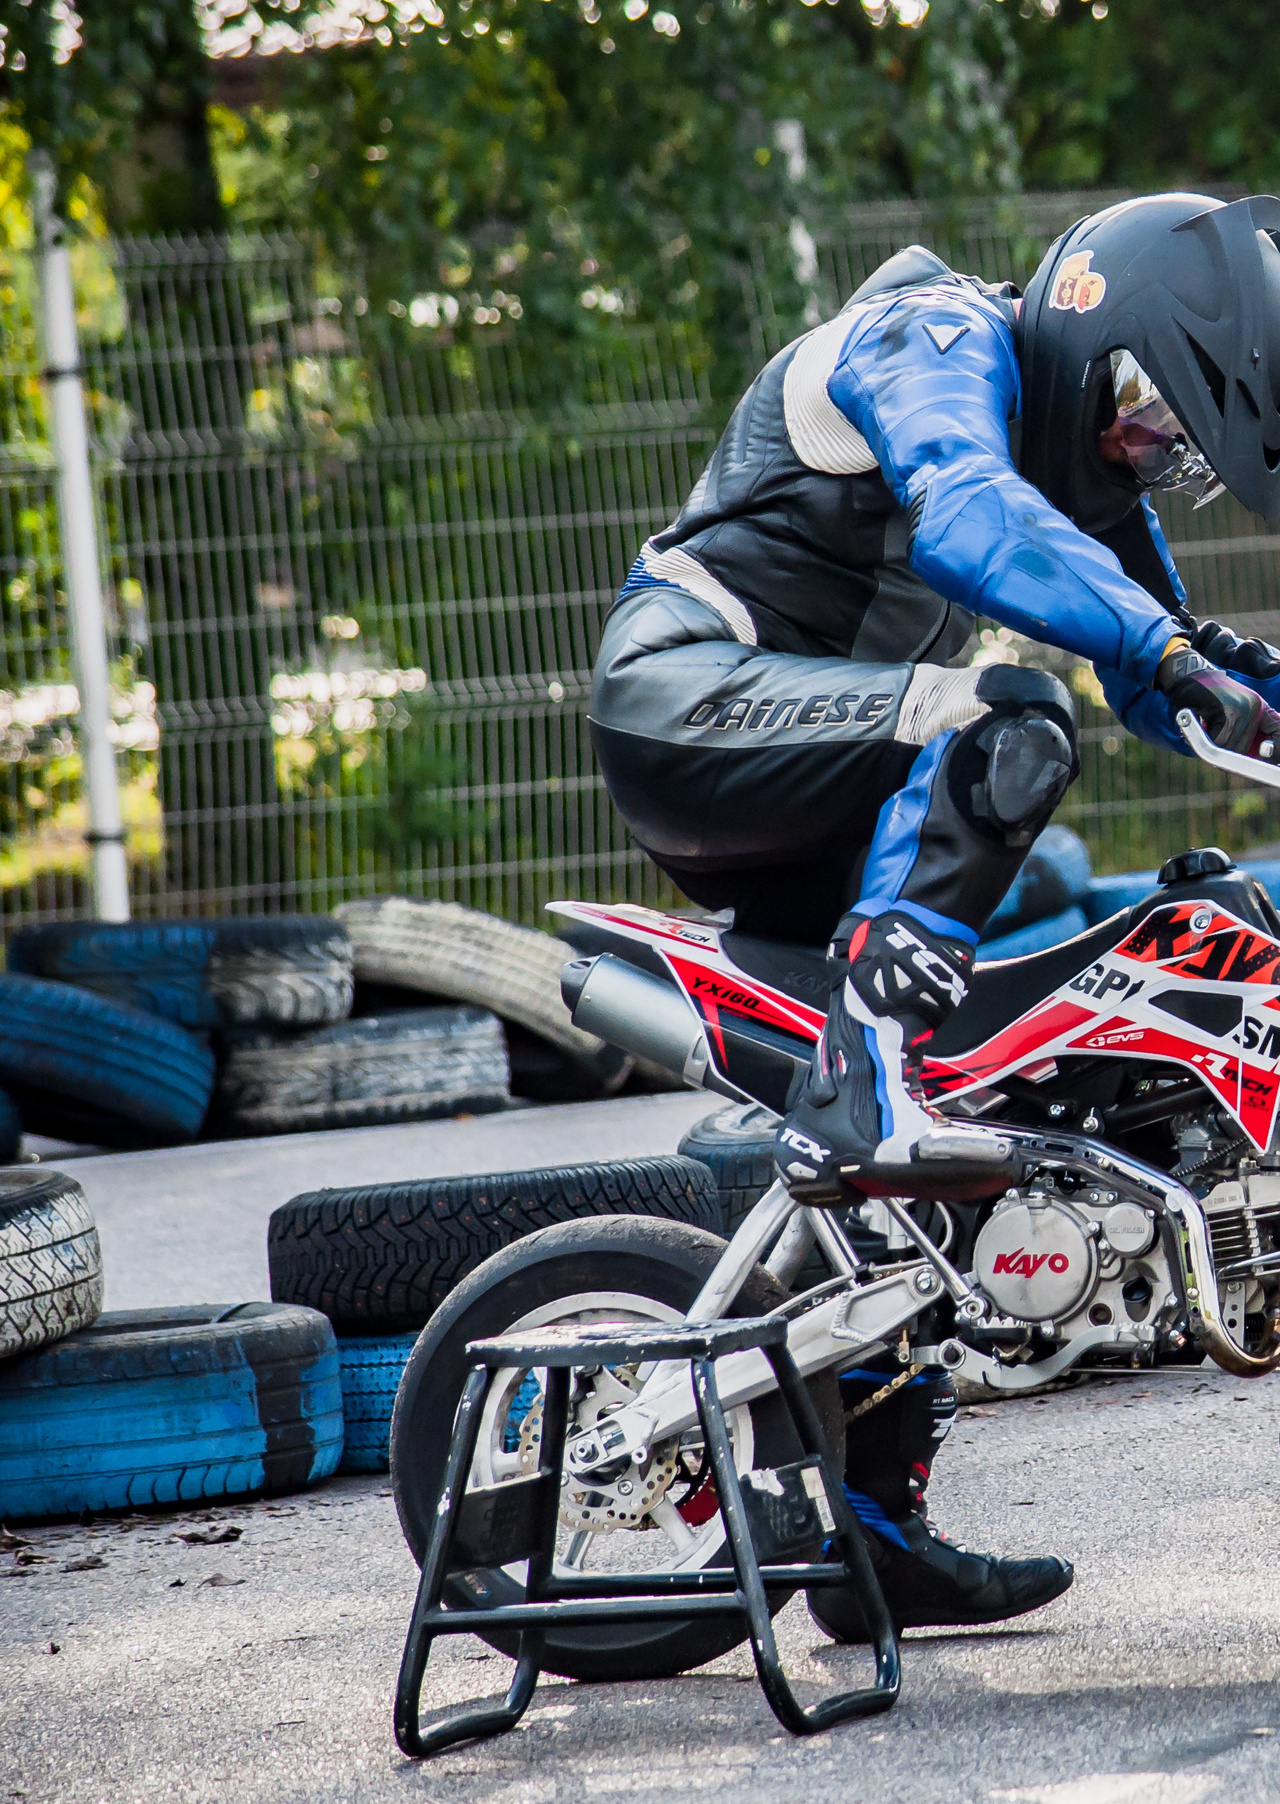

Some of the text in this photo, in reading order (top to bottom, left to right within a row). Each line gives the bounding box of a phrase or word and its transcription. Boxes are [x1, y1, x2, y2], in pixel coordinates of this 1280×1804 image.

[683, 693, 894, 731] DAINESE
[885, 921, 969, 1007] TCX
[692, 977, 760, 1009] YX160
[780, 1127, 831, 1163] TCX
[992, 1246, 1070, 1279] KAYO
